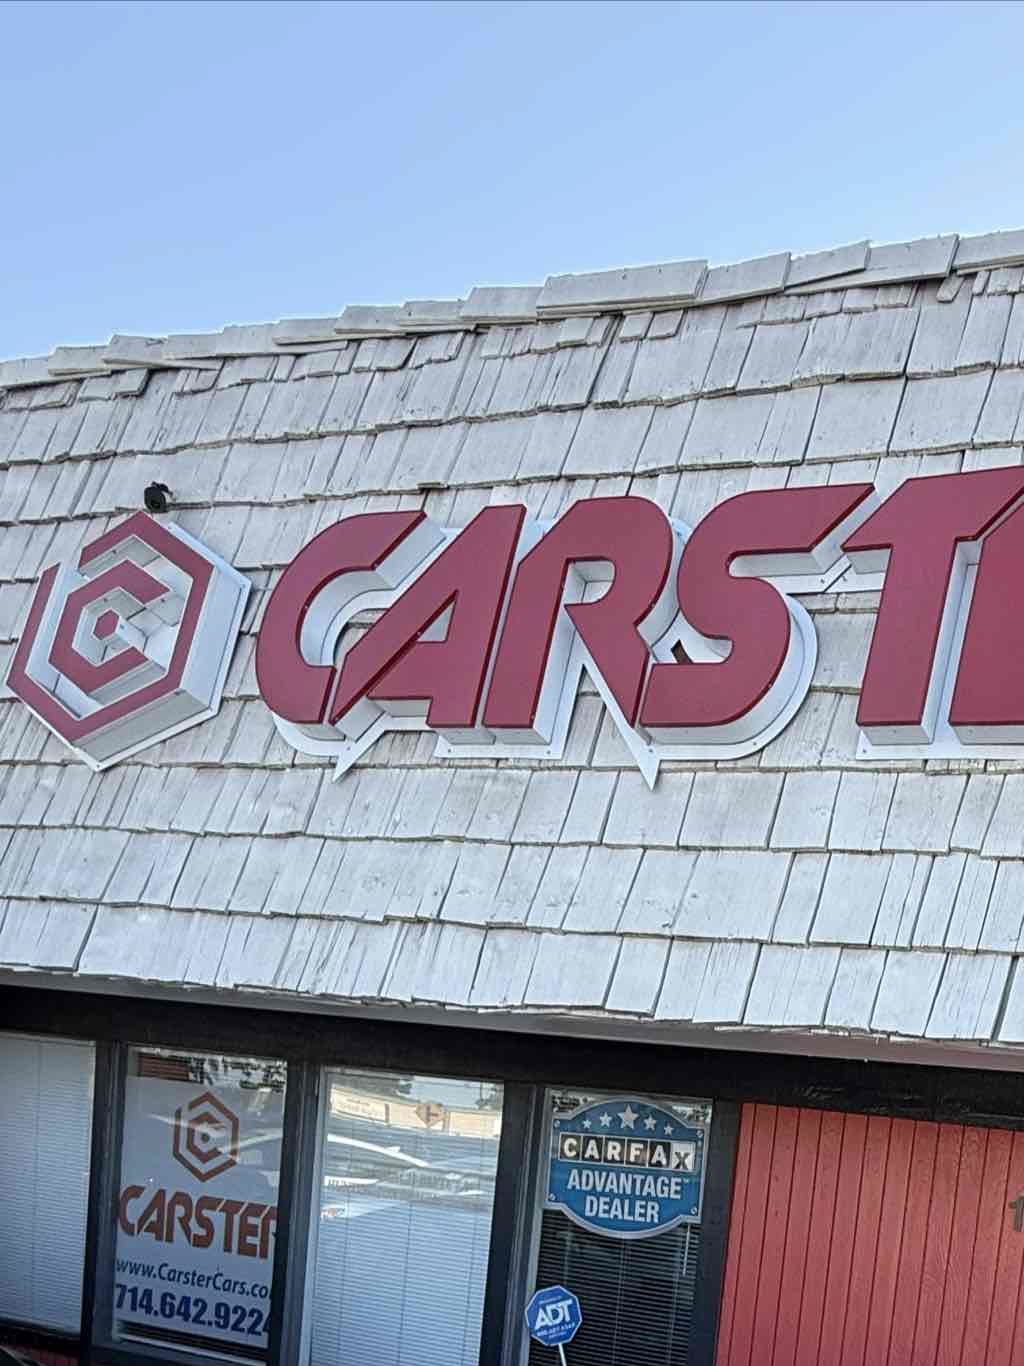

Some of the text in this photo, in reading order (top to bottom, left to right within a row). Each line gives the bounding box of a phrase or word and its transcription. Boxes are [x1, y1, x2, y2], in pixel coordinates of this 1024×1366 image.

[563, 1136, 694, 1170] CARFAX
[584, 1195, 661, 1223] DEALER
[535, 1298, 573, 1329] ADT
